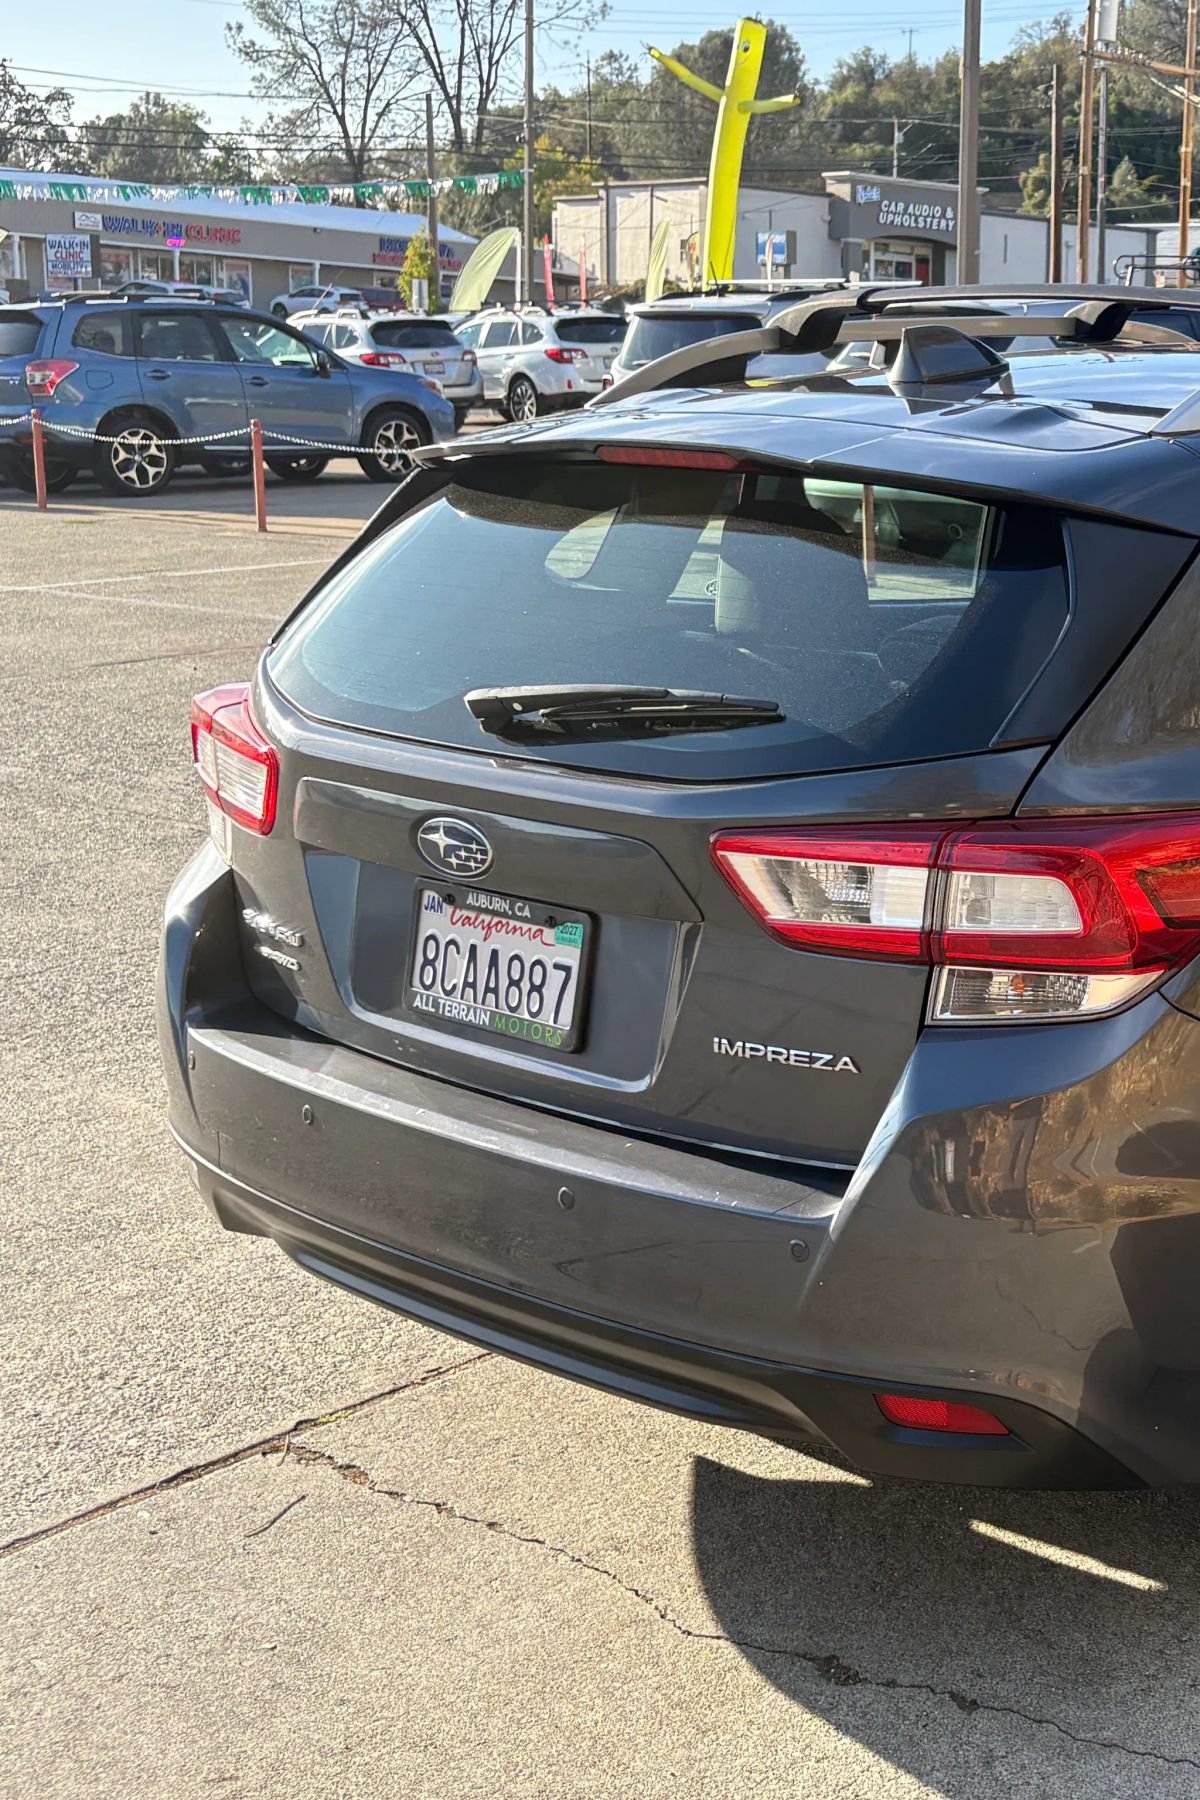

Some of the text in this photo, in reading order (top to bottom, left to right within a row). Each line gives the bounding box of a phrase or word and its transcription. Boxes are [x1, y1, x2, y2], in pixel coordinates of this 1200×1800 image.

[881, 199, 954, 219] CAR AUDIO &
[879, 211, 955, 231] UPHOLSTERY
[186, 224, 241, 243] CLINIC
[54, 250, 83, 260] CLINIC
[424, 893, 445, 915] JAN
[466, 891, 532, 919] AUBURN, CA
[449, 906, 555, 947] California
[560, 924, 579, 937] 2027
[418, 932, 574, 1026] 8CAA887
[413, 993, 564, 1046] ALL TERRAIN MOTORS
[713, 1037, 860, 1074] IMPREZA
